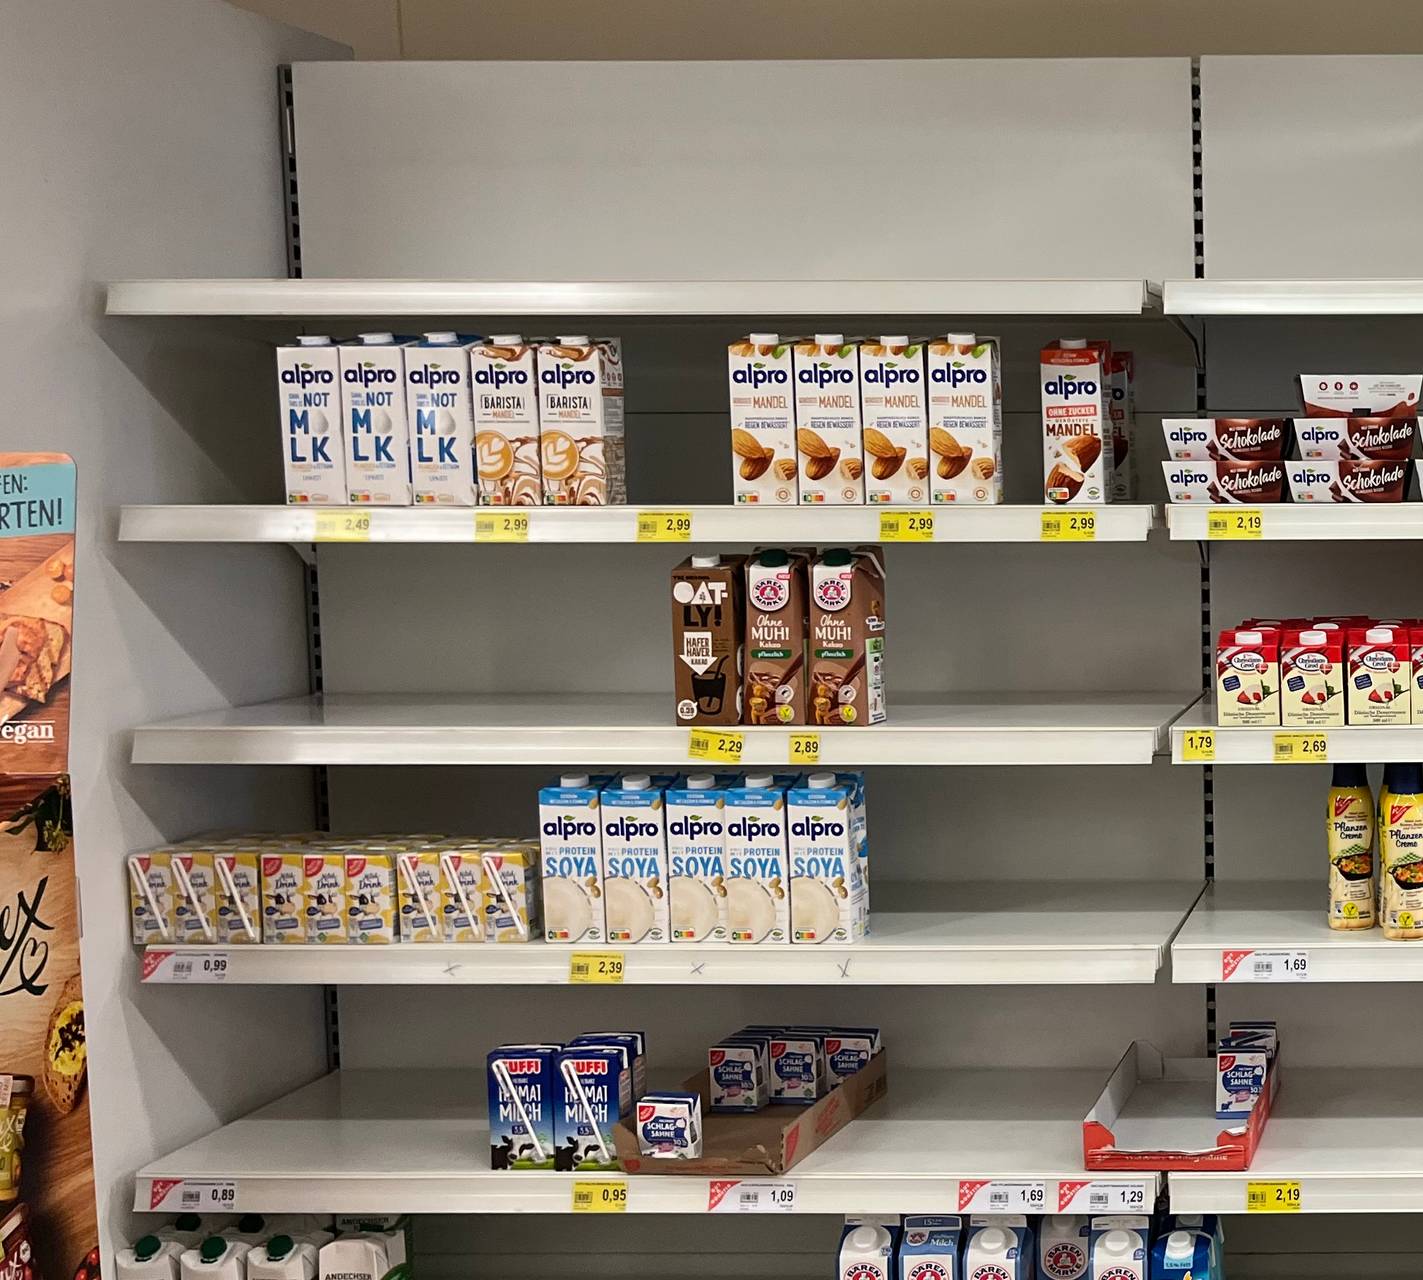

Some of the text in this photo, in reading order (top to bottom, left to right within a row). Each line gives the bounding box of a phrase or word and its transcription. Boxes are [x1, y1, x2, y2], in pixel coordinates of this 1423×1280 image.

[932, 363, 986, 388] alpro
[1045, 375, 1096, 399] alpro
[303, 393, 330, 406] NOT
[366, 392, 392, 406] NOT
[431, 393, 457, 406] NOT
[484, 397, 522, 410] BARISTA
[550, 397, 588, 409] BARISTA
[753, 396, 788, 408] MANDEL
[819, 396, 854, 408] MANDEL
[885, 396, 920, 408] MANDEL
[951, 395, 987, 408] MANDEL
[1049, 407, 1095, 417] OHNE ZUCKER
[1047, 424, 1098, 436] MANDEL
[418, 438, 456, 462] LK
[1343, 469, 1404, 491] Schokolade
[345, 519, 369, 531] 2,49
[504, 519, 528, 531] 2,99
[666, 518, 690, 532] 2,99
[909, 517, 932, 531] 2,99
[1070, 517, 1094, 531] 2,99
[1237, 517, 1261, 529] 2,19
[684, 605, 722, 626] LY!
[757, 615, 783, 626] Ohne
[820, 615, 845, 626] Ohne
[752, 627, 790, 640] MUH!
[686, 638, 709, 647] HAFER
[686, 648, 709, 657] HAVER
[718, 739, 742, 753] 2,29
[795, 741, 818, 754] 2,89
[1188, 737, 1212, 749] 1,79
[1303, 740, 1326, 754] 2,69
[543, 816, 595, 840] alpro
[606, 817, 658, 841] alpro
[670, 816, 722, 840] alpro
[728, 817, 780, 841] alpro
[792, 816, 843, 840] alpro
[1390, 829, 1423, 841] Pflanzen
[1395, 839, 1418, 848] Creme
[560, 847, 596, 855] PROTEIN
[622, 848, 658, 856] PROTEIN
[686, 847, 722, 855] PROTEIN
[744, 848, 780, 856] PROTEIN
[807, 847, 844, 856] PROTEIN
[546, 857, 597, 877] SOYA
[608, 858, 659, 878] SOYA
[673, 856, 724, 877] SOYA
[731, 858, 781, 878] SOYA
[794, 857, 844, 878] SOYA
[204, 959, 227, 973] 0,99
[599, 961, 622, 975] 2,39
[1284, 959, 1307, 972] 1,69
[647, 1122, 677, 1130] SCHLAG-
[211, 1188, 234, 1202] 0,89
[602, 1189, 626, 1201] 0,95
[771, 1190, 793, 1202] 1,09
[1020, 1188, 1043, 1202] 1,69
[1120, 1190, 1143, 1203] 1,29
[1275, 1188, 1300, 1202] 2,19
[930, 1238, 954, 1247] Milch
[325, 1272, 372, 1280] ANDECHSER
